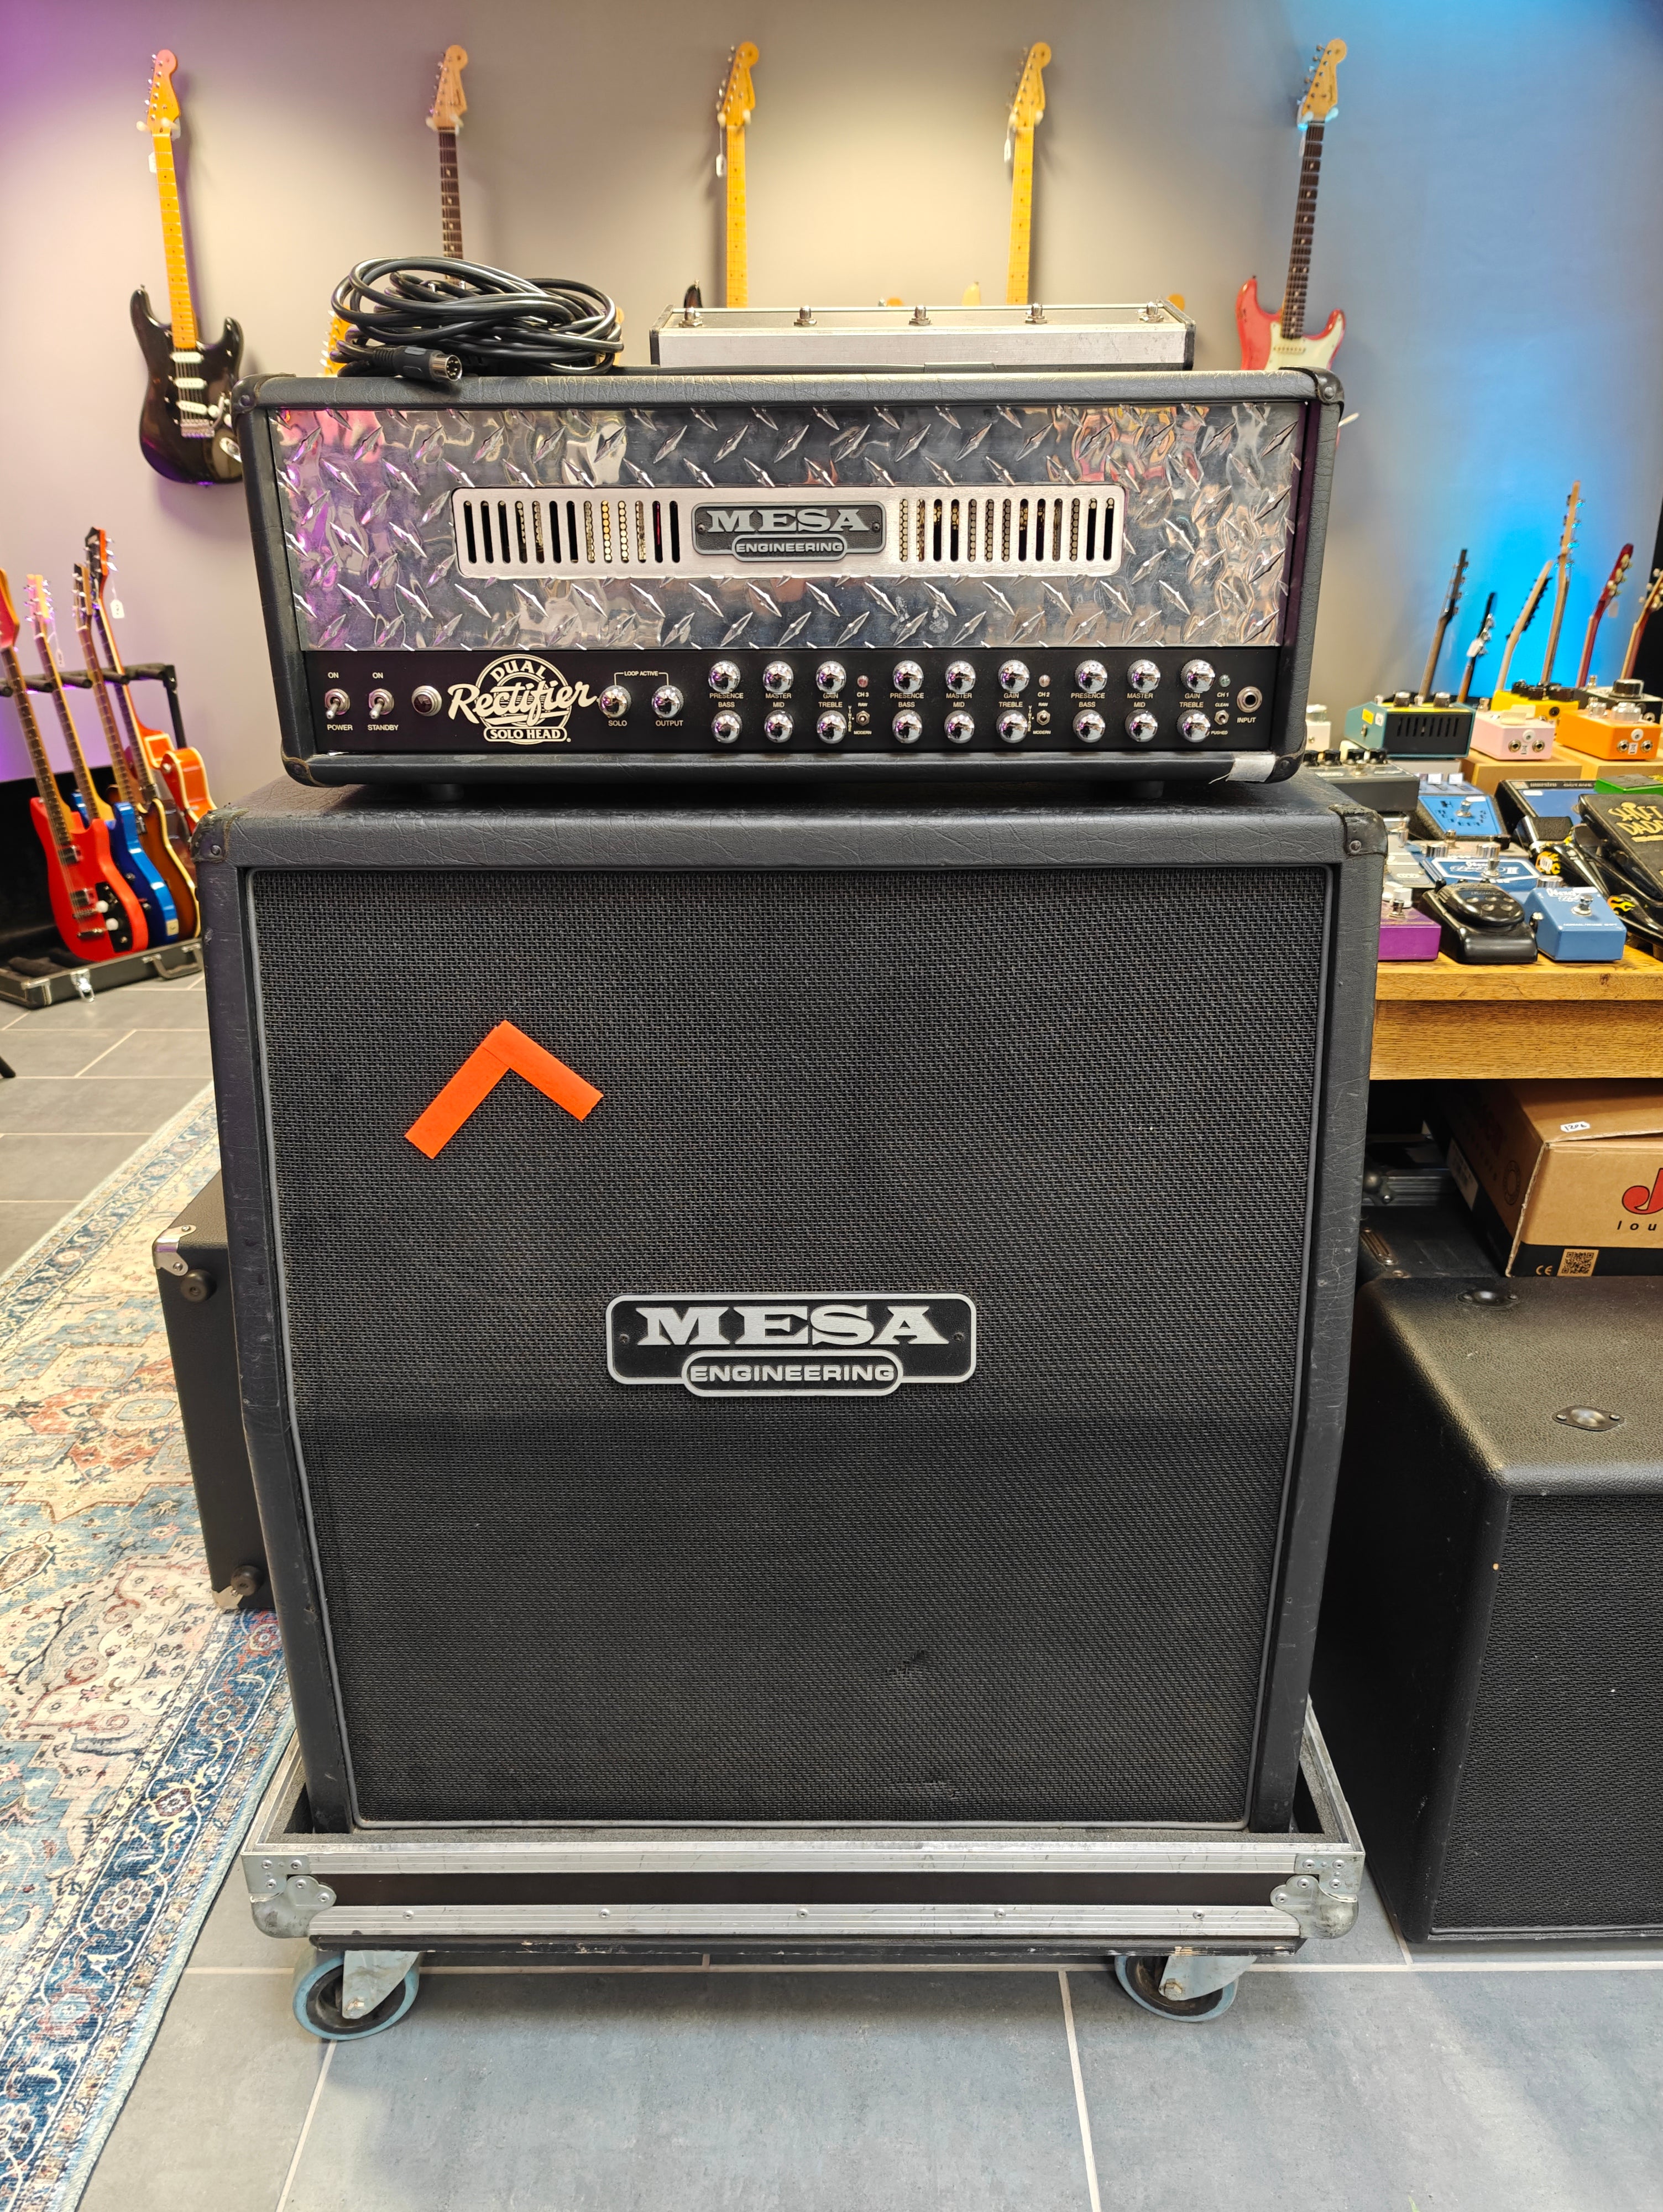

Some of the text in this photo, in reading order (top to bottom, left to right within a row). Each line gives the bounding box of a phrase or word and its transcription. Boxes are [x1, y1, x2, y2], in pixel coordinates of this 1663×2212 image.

[706, 508, 870, 533] MESA
[735, 542, 844, 552] ENGINEERING
[490, 660, 546, 682] DUAL
[447, 680, 598, 727] Rectifier
[490, 729, 561, 739] SOLO HEAD
[635, 1305, 950, 1345] MESA
[690, 1365, 895, 1382] ENGINEERING
